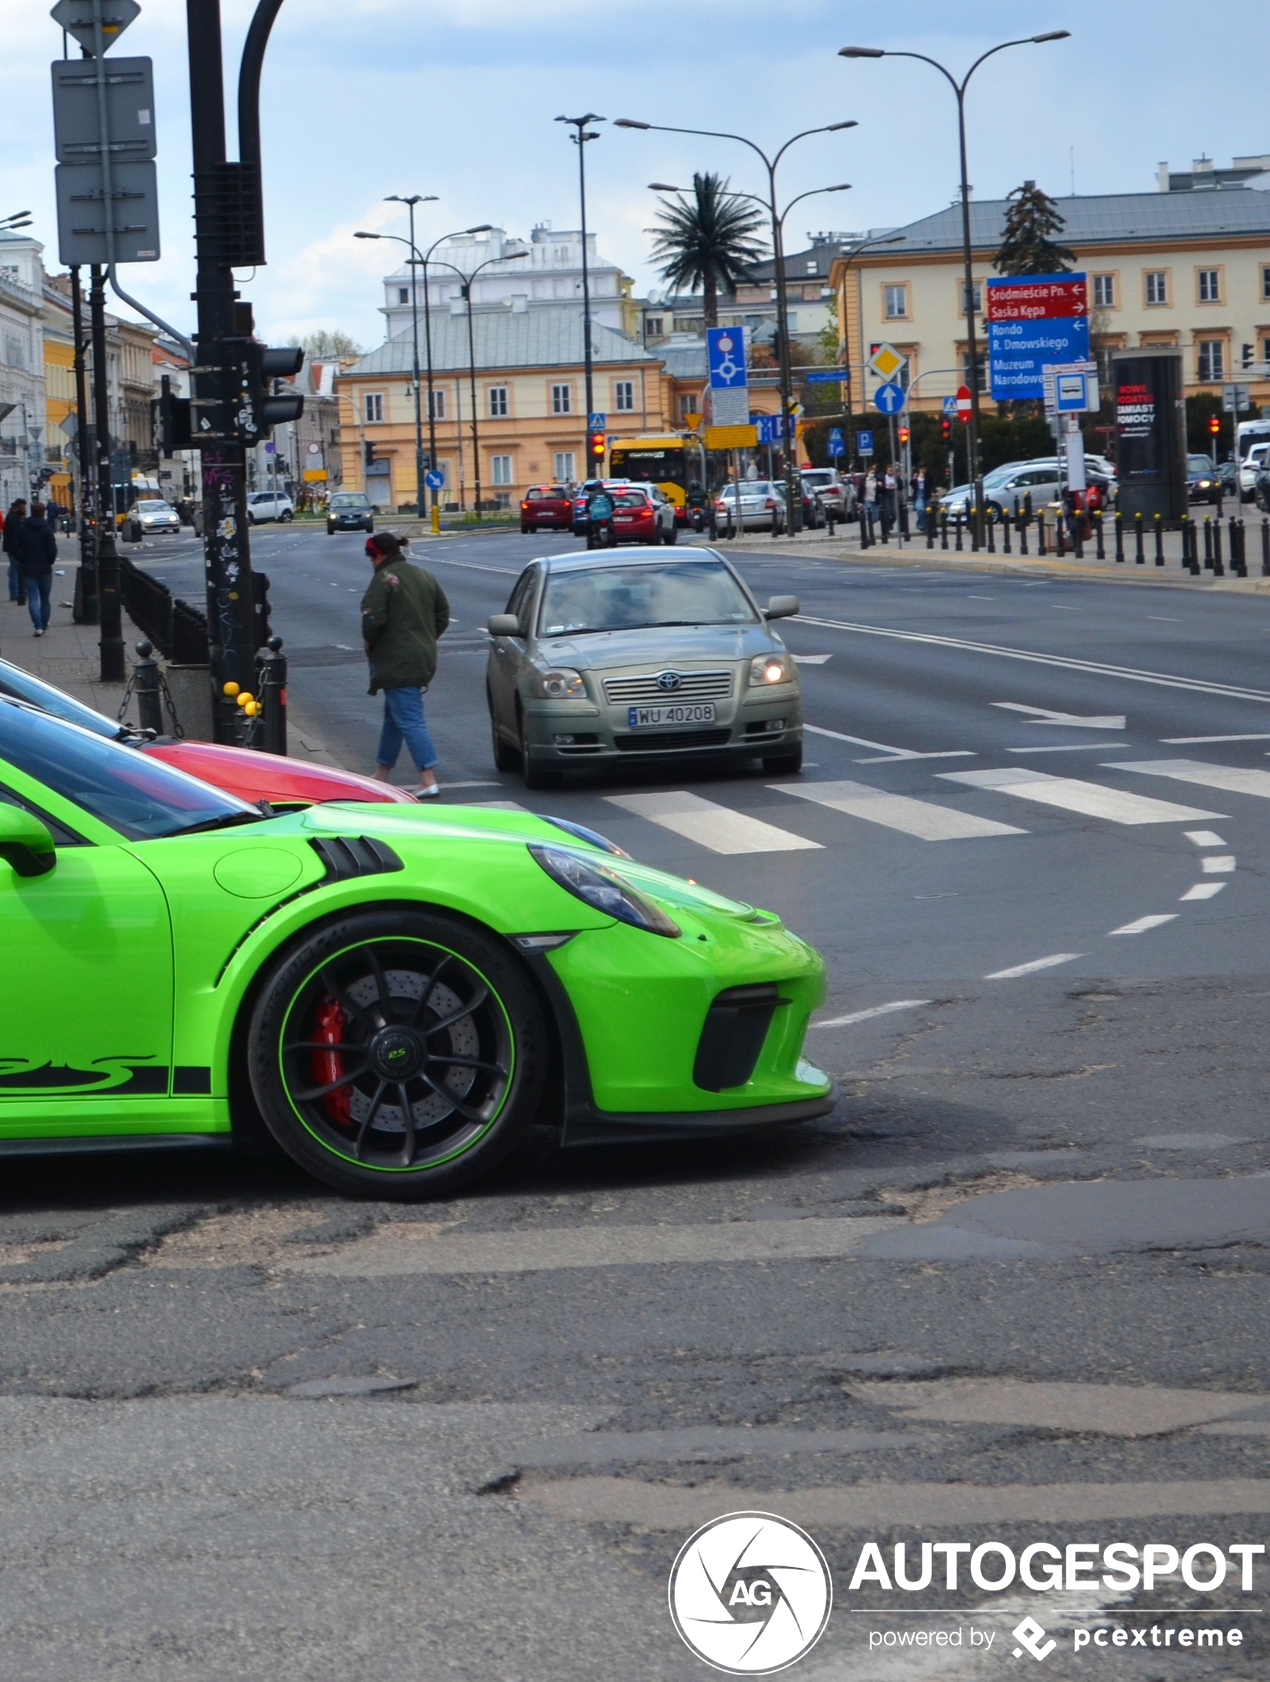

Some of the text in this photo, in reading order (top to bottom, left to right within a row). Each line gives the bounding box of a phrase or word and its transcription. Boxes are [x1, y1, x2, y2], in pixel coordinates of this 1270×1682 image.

[991, 286, 1067, 301] Śródmieście Pn.
[991, 305, 1046, 318] Saska Kępa
[992, 324, 1023, 336] Rondo
[993, 337, 1069, 351] R. Dmowskiego
[993, 359, 1034, 370] Muzeum
[994, 373, 1045, 385] Narodowe
[1119, 385, 1147, 394] NOWE
[639, 706, 712, 724] WU 40208
[388, 1048, 405, 1059] RS
